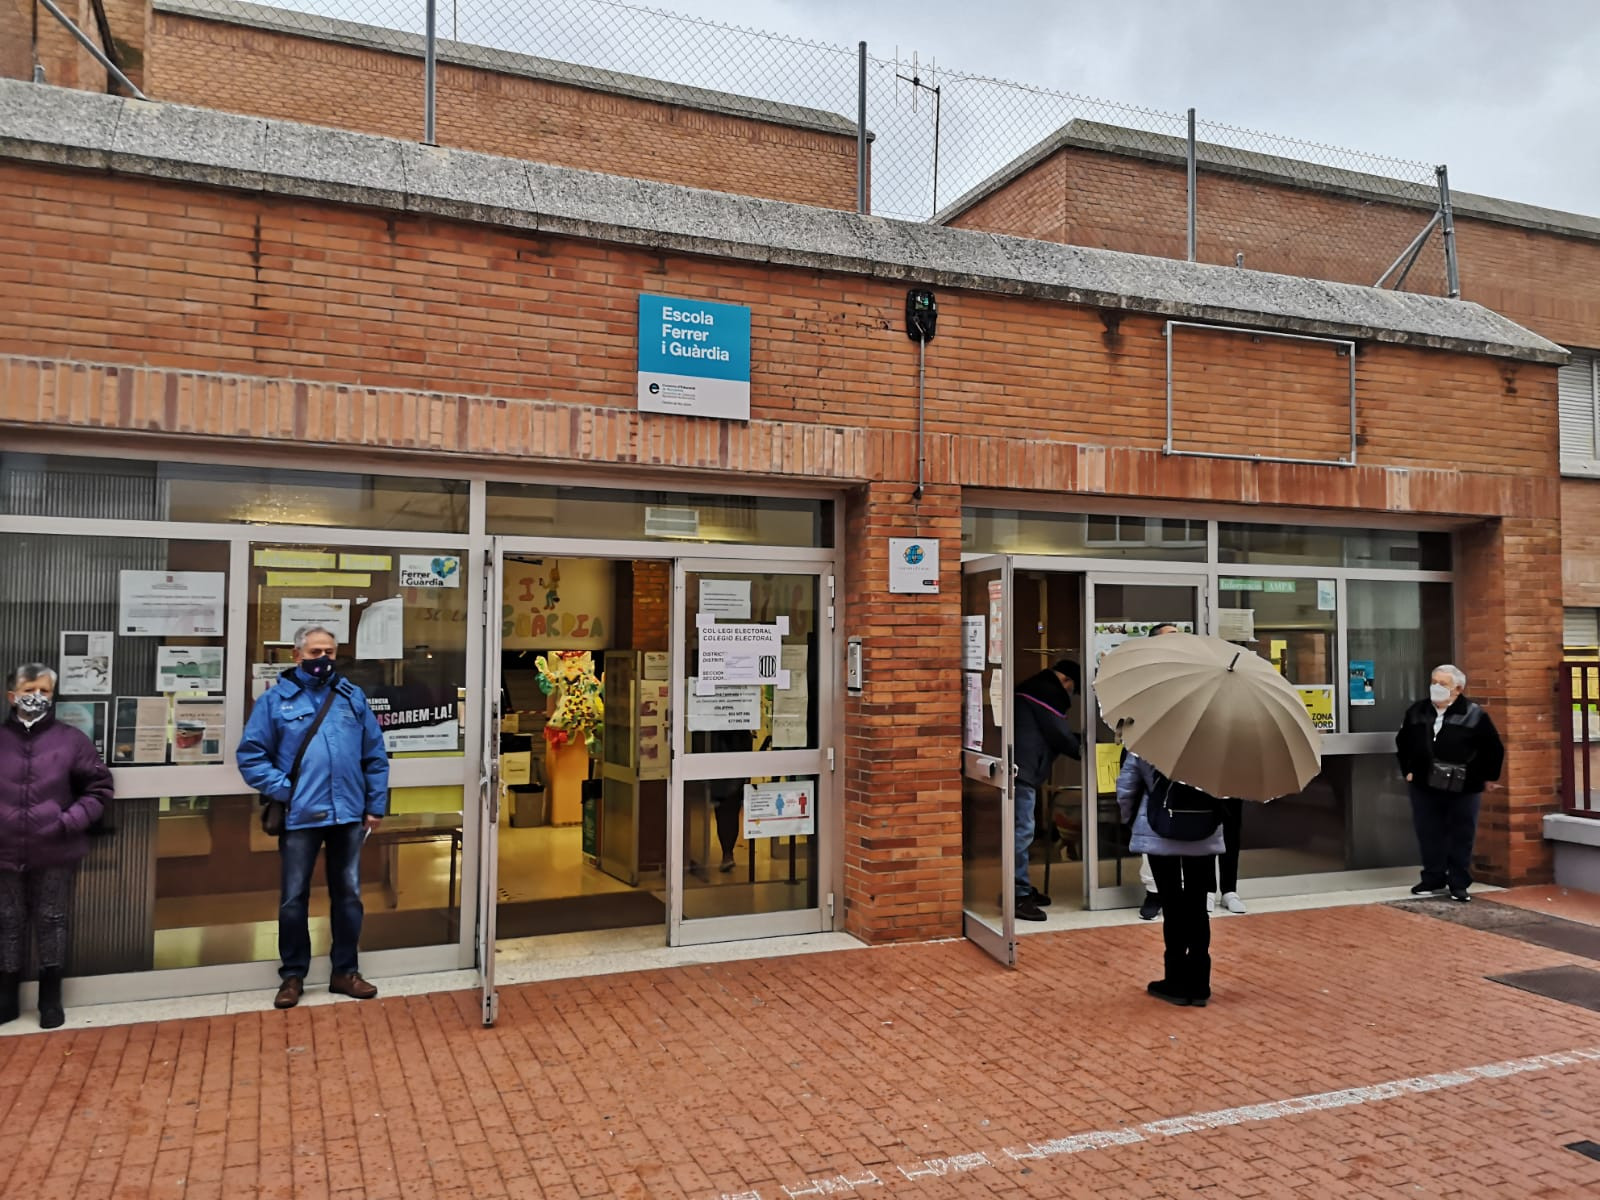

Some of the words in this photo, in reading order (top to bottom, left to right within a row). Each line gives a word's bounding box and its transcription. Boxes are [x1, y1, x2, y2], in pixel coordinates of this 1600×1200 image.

[662, 306, 714, 325] Escola
[662, 323, 709, 342] Ferrer
[661, 341, 666, 354] i
[669, 342, 730, 361] Guàrdia
[402, 570, 430, 578] Ferrer
[377, 703, 453, 726] ASCAREM-LA!
[1311, 712, 1334, 721] ZONA
